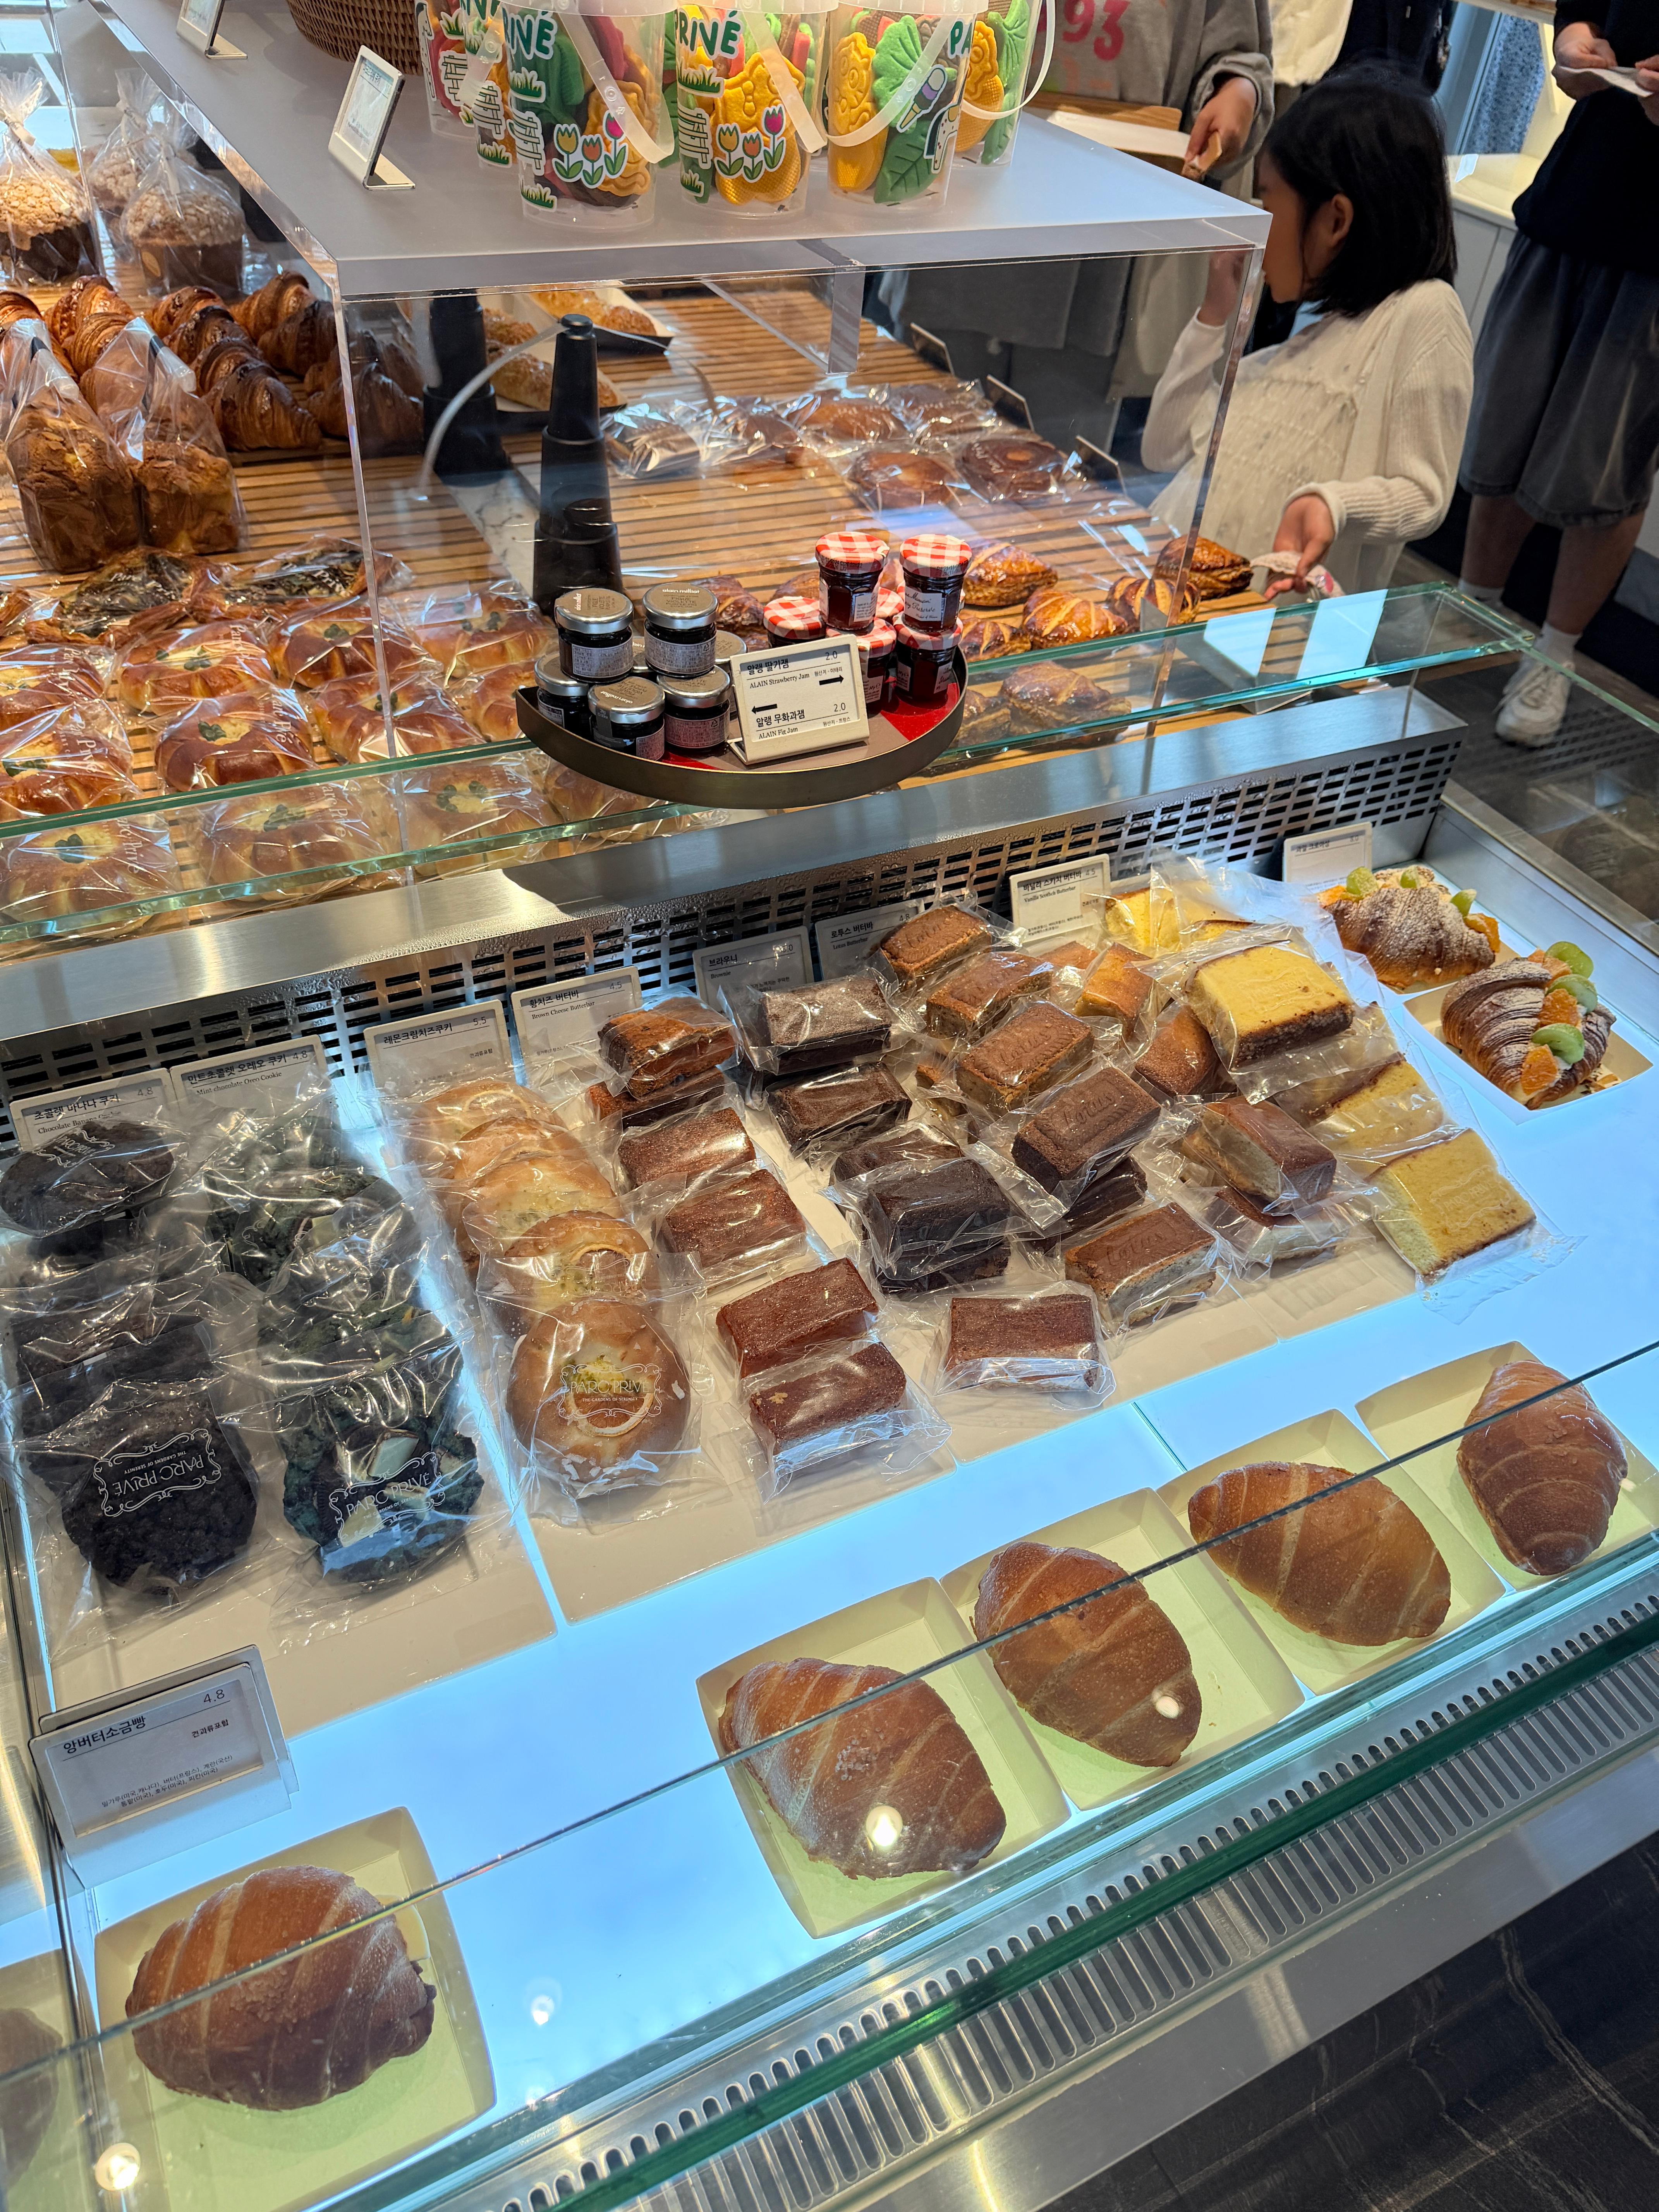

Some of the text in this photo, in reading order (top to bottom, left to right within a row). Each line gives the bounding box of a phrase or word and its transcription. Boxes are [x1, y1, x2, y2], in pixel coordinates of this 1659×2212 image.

[502, 7, 555, 55] RIVÉ
[1038, 0, 1130, 60] 93
[825, 651, 838, 661] 2.0
[747, 658, 789, 675] 알랭 딸기잼
[750, 680, 768, 689] ALAIN
[769, 675, 798, 685] Strawberry
[834, 702, 846, 712] 2.0
[756, 709, 805, 727] 알랭 무화과잼
[759, 730, 777, 739] ALAIN
[322, 785, 338, 805] arc
[1022, 871, 1081, 891] 바닐라 스카치 버터바
[1024, 895, 1039, 903] Vanilla
[831, 922, 873, 939] 로투스 버터바
[709, 954, 738, 967] 브라우니
[711, 970, 731, 979] Brownie
[610, 982, 622, 990] 4.5
[529, 990, 579, 1008] 황치즈 버터바
[551, 1007, 569, 1015] Cheese
[570, 1001, 595, 1011] Butterbar
[473, 1017, 487, 1026] 5.5
[384, 1023, 453, 1044] 레몬크림치즈쿠키
[293, 1050, 308, 1060] 4.8
[188, 1054, 287, 1084] 민트초콜렛 오레오 쿠키
[214, 1081, 242, 1092] chocolate
[261, 1071, 282, 1080] Cookie
[137, 1087, 153, 1097] 4.8
[67, 1099, 97, 1113] 바나나
[100, 1094, 120, 1106] 쿠키
[38, 1123, 71, 1134] Chocolate
[570, 1380, 610, 1394] PARC
[155, 1454, 176, 1464] GARDENS
[112, 1455, 204, 1496] PARC PRIVÉ
[124, 1465, 146, 1475] SERENITY
[345, 1472, 432, 1517] PARC PRIVÉ
[203, 1689, 225, 1704] 4.8
[63, 1716, 146, 1754] 앙버터소금빵
[192, 1719, 229, 1738] 견과류포함
